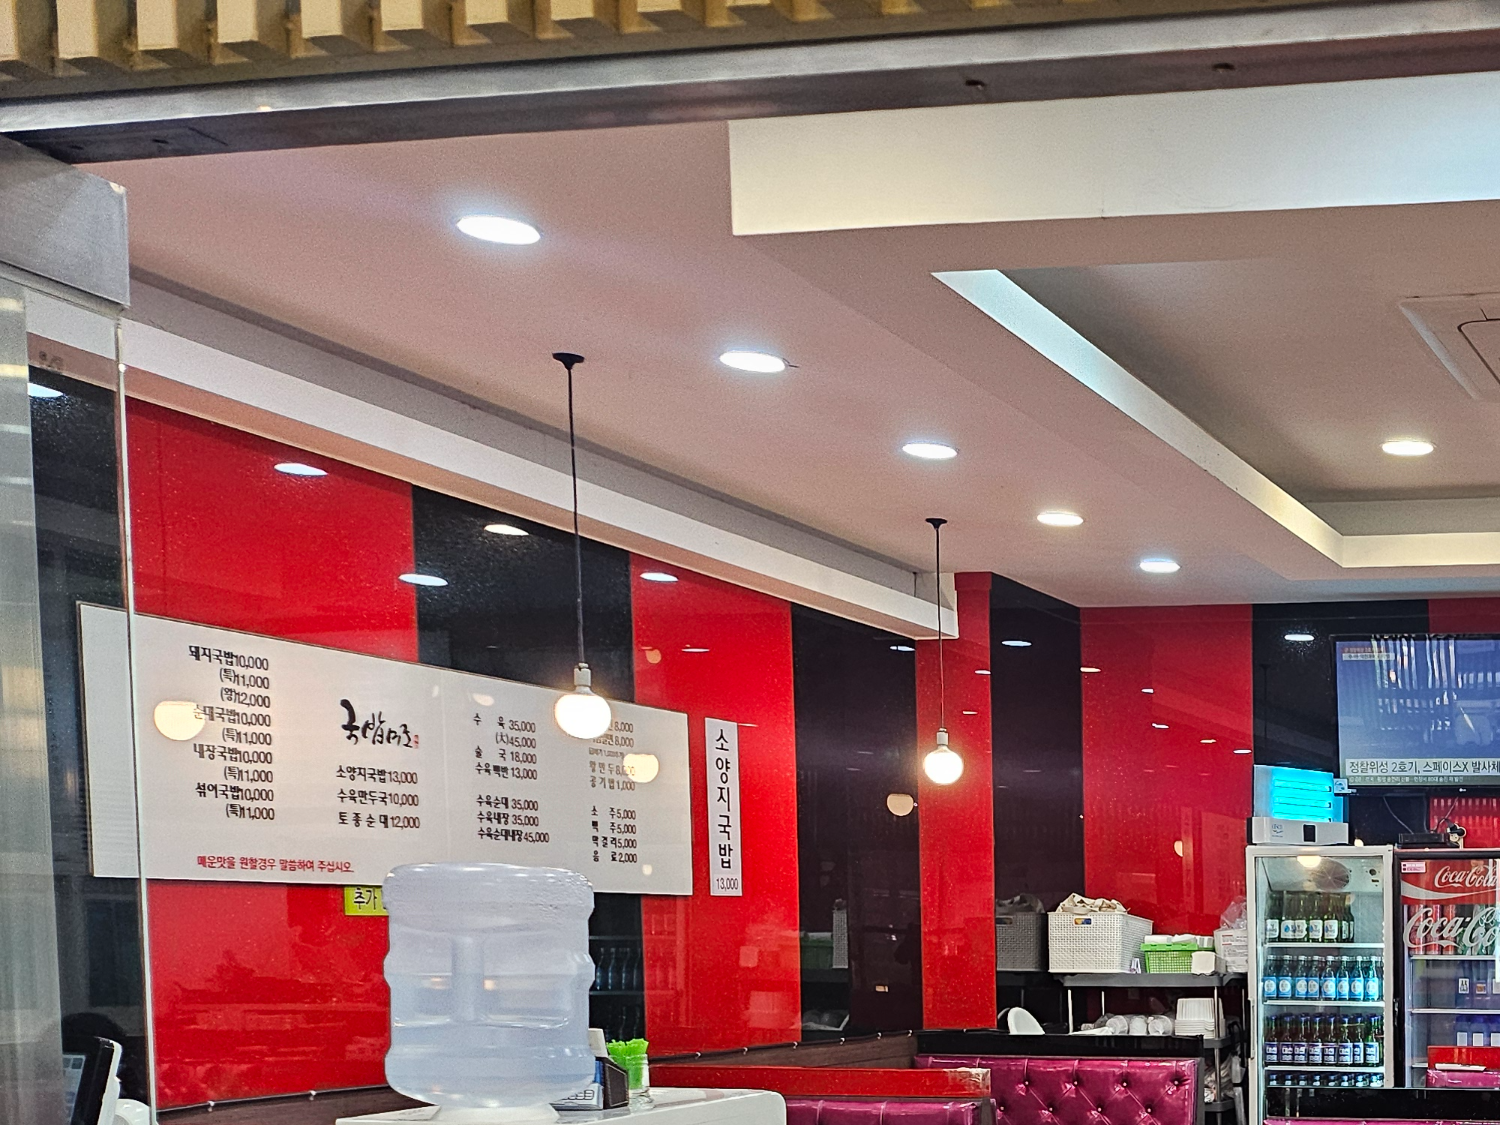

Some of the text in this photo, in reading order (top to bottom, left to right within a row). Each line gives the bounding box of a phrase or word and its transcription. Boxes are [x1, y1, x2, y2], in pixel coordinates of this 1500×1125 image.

[508, 719, 536, 733] 35,000
[510, 751, 537, 765] 18,000
[511, 767, 538, 780] 13,000
[1349, 760, 1389, 774] 정찰위성
[1391, 760, 1420, 774] 2호기,
[1422, 760, 1469, 774] 스페이스X
[1471, 760, 1500, 774] 발사체
[511, 798, 539, 812] 35,000
[511, 814, 539, 827] 35,000
[197, 855, 236, 869] 매운맛을
[239, 857, 276, 871] 원할경우
[279, 858, 314, 872] 말씀하여
[716, 877, 739, 891] 13,000
[353, 886, 377, 910] 추가
